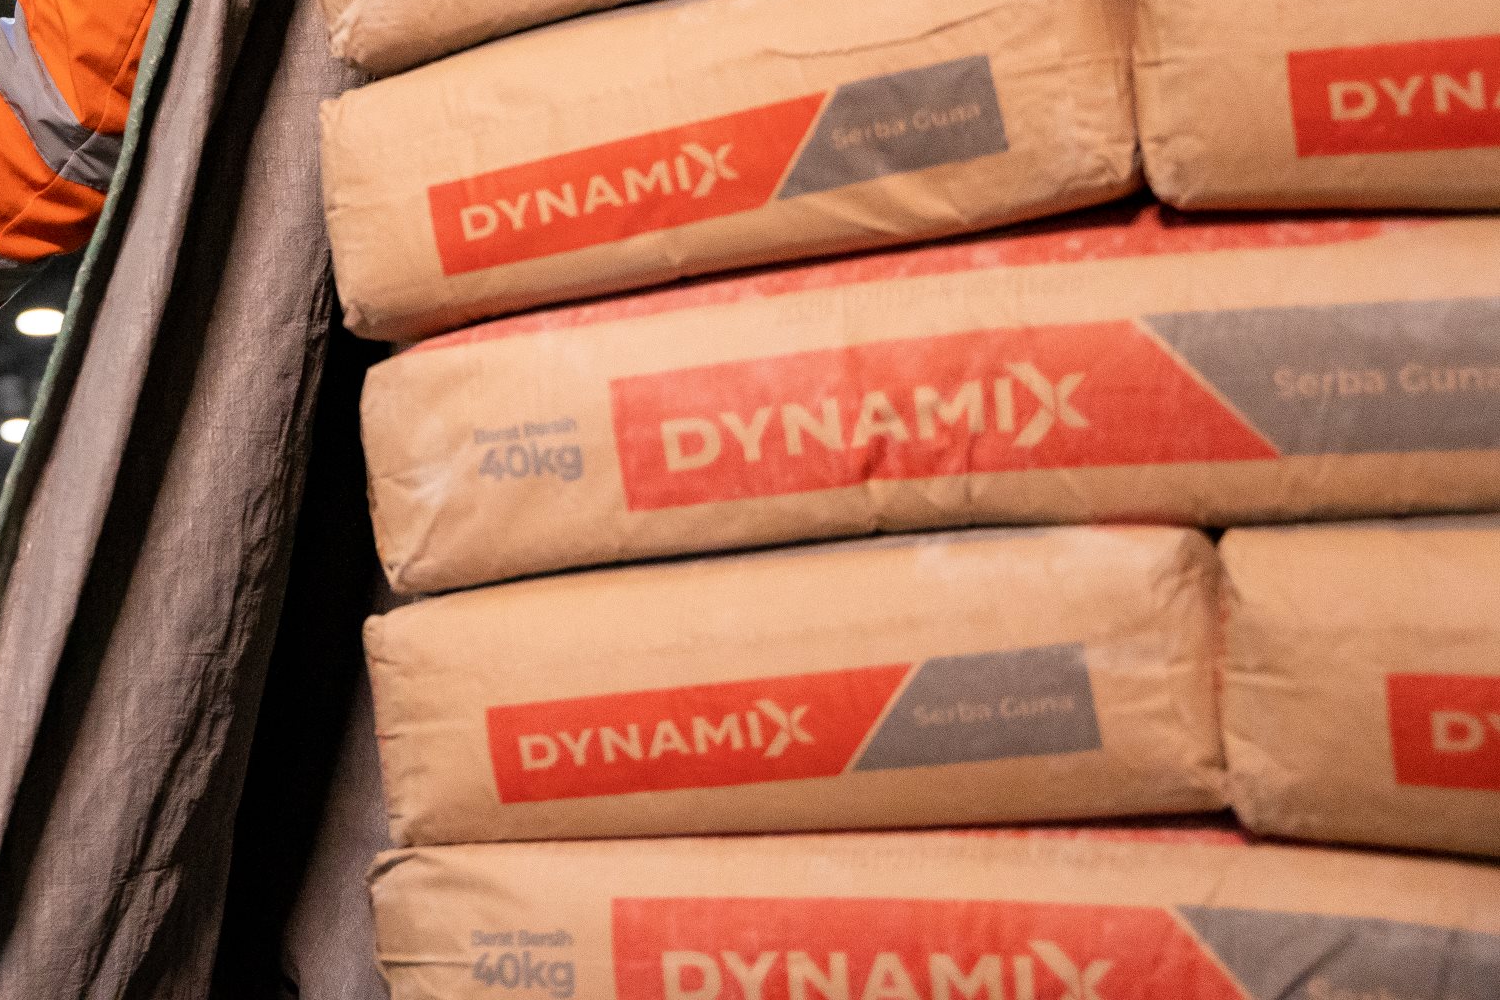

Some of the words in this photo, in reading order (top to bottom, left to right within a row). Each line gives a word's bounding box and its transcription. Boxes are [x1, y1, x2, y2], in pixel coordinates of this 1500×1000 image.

[1327, 70, 1500, 121] DYN
[460, 143, 739, 241] DYNAMIX
[832, 115, 906, 149] Serba
[912, 101, 981, 130] Guna
[660, 362, 1090, 472] DYNAMIX
[1273, 365, 1386, 398] Serba
[479, 440, 583, 481] 40kg
[518, 700, 815, 771] DYNAMIX
[1431, 711, 1500, 752] D
[472, 951, 574, 998] 40kg
[661, 941, 1114, 1000] DYNAMIX
